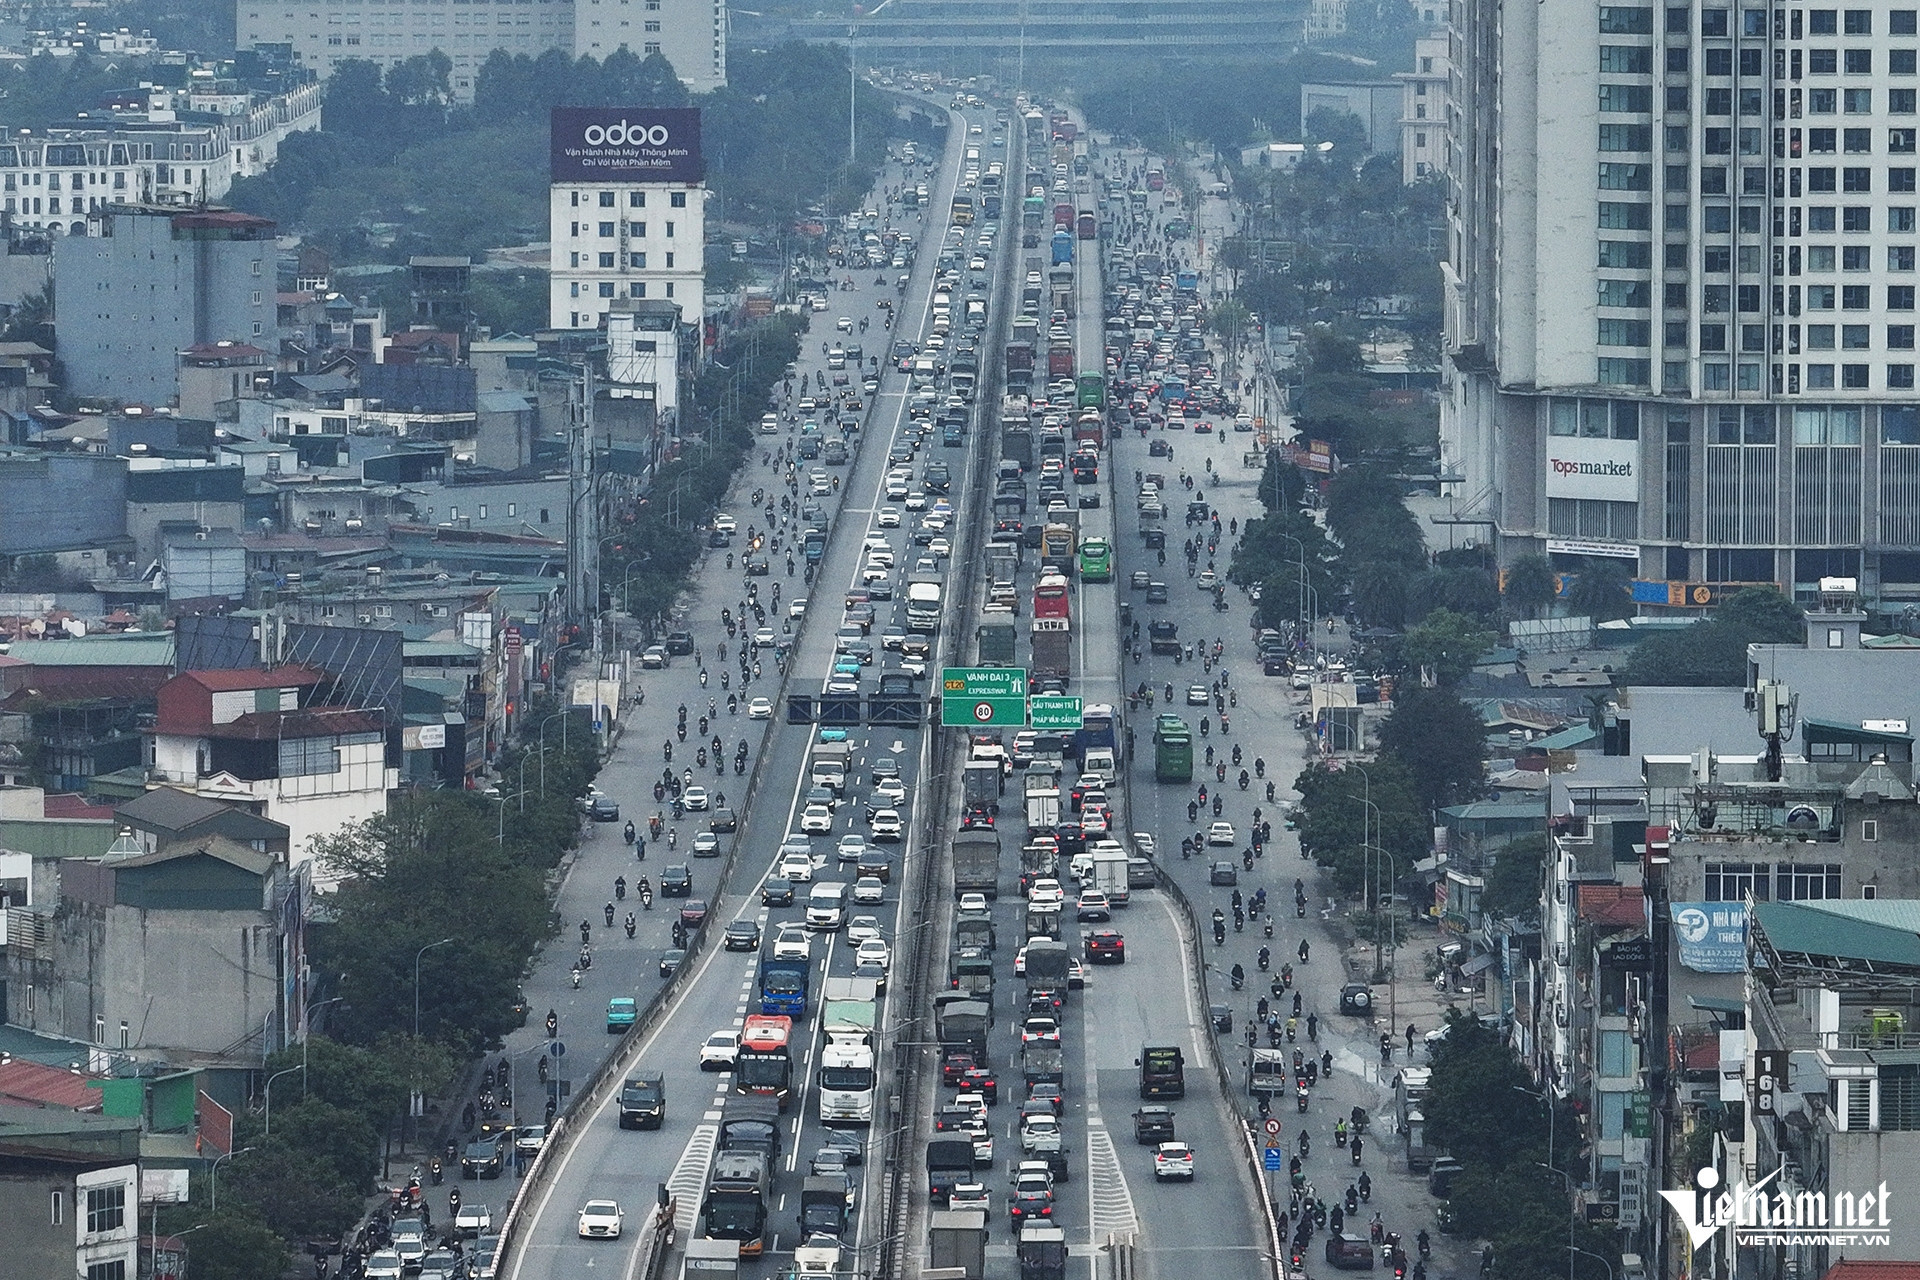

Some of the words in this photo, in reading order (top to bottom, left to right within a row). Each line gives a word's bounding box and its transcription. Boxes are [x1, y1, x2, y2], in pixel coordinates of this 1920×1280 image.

[584, 119, 669, 146] odoo
[565, 148, 581, 157] Vận
[582, 148, 603, 156] Hành
[604, 148, 620, 156] Nhà
[622, 148, 639, 157] Máy
[641, 148, 666, 158] Thông
[668, 148, 688, 156] Minh
[1005, 673, 1010, 681] 3
[968, 687, 1007, 695] EXPRESSWAY
[978, 708, 989, 717] 80
[1713, 908, 1729, 927] NHÀ
[1623, 1169, 1637, 1180] NHA
[1622, 1185, 1639, 1195] KHOA
